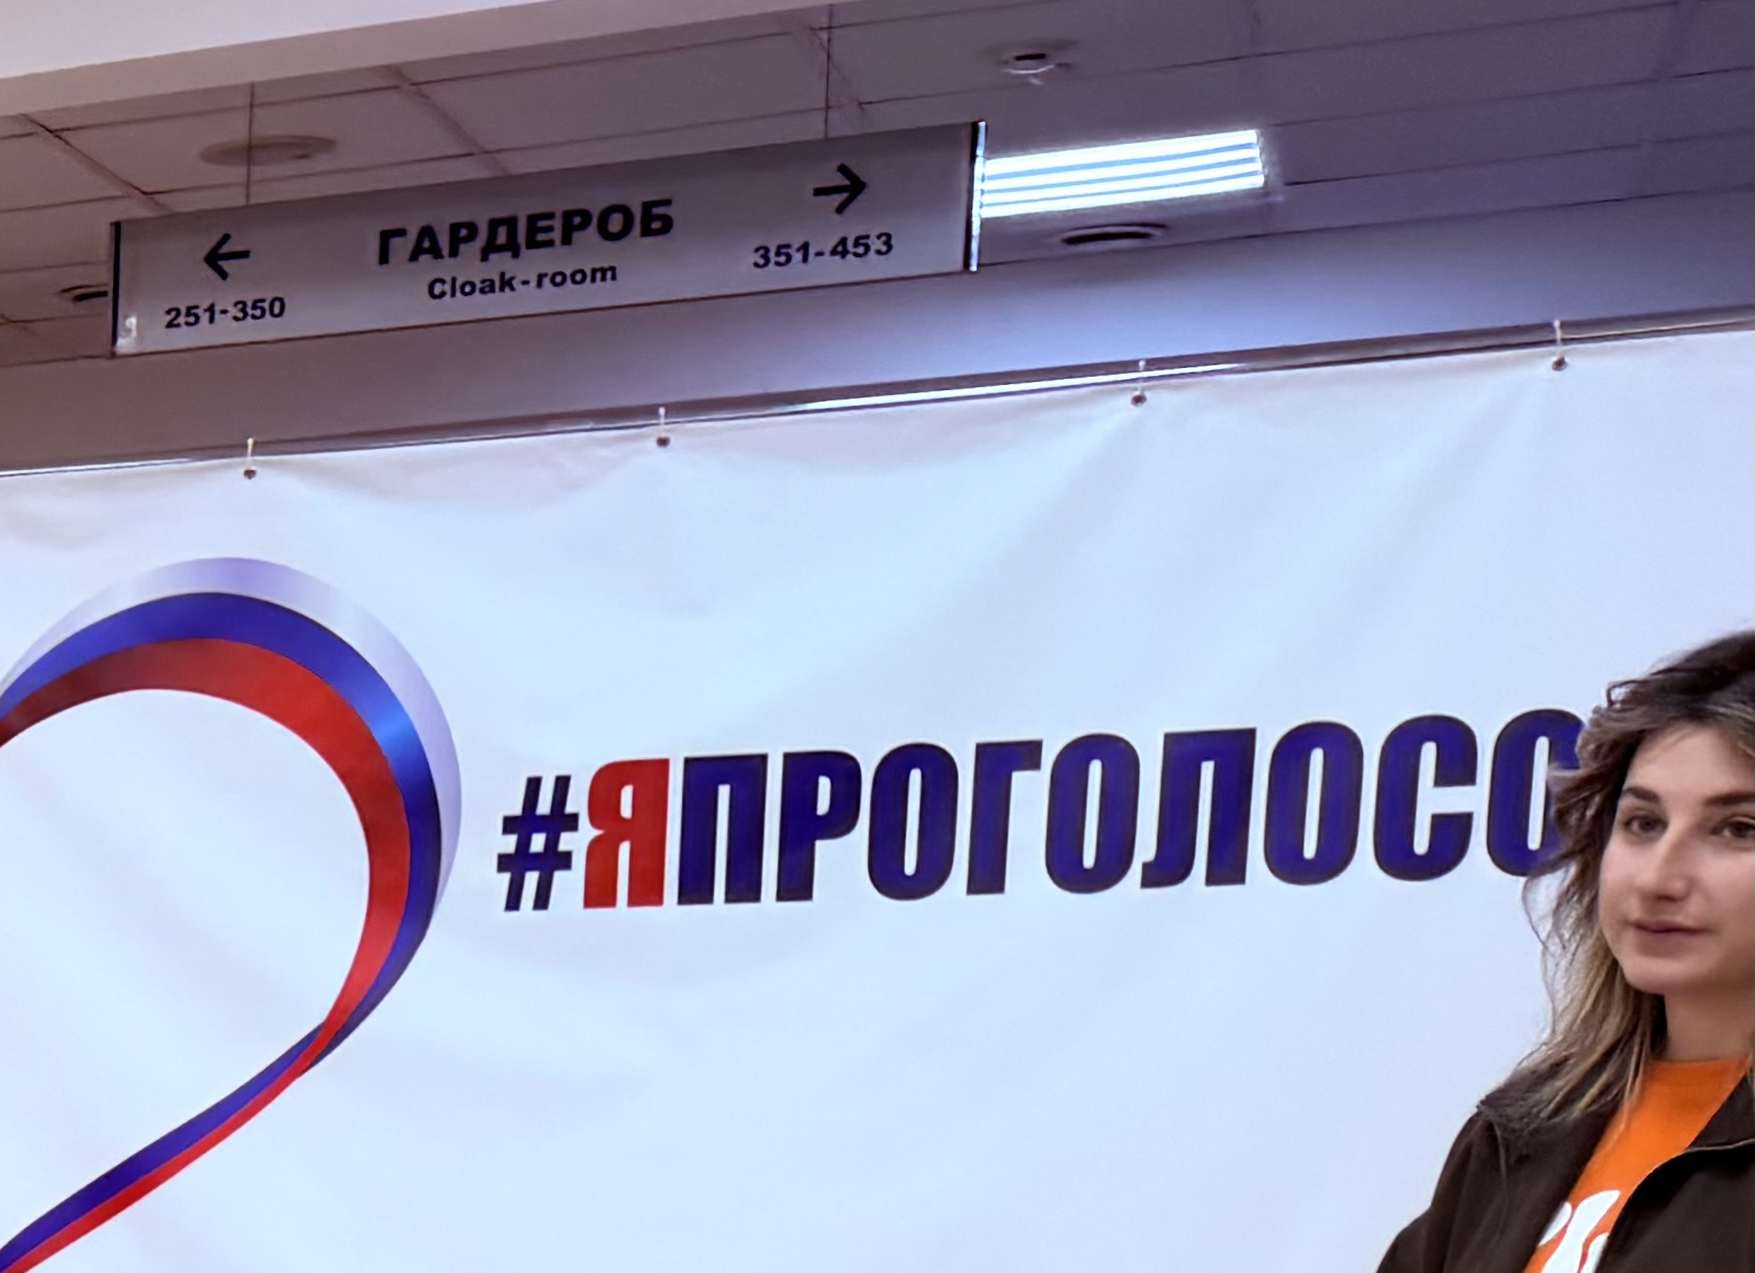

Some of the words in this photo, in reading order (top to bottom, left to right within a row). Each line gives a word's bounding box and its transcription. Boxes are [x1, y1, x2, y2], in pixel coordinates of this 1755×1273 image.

[378, 198, 674, 266] ГАРДЕРОБ
[752, 231, 894, 269] 351-453
[427, 264, 619, 300] Cloak-room
[164, 296, 287, 329] 251-350
